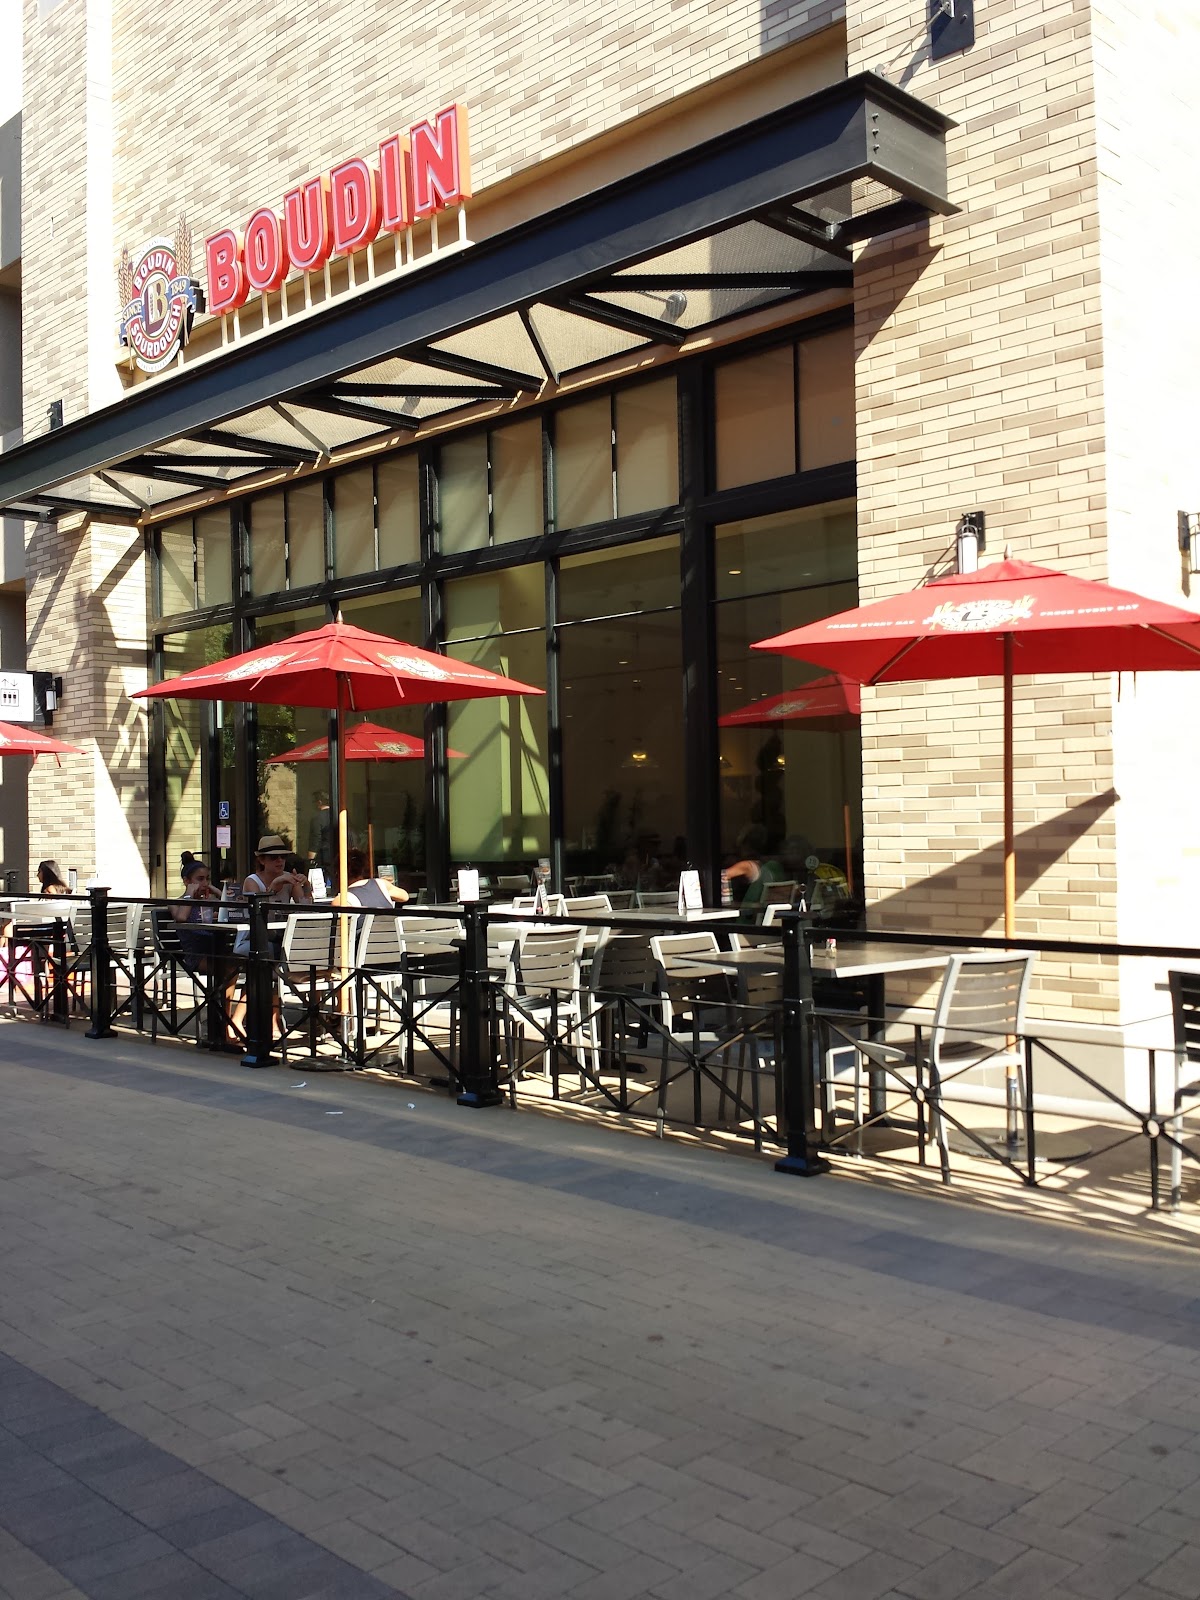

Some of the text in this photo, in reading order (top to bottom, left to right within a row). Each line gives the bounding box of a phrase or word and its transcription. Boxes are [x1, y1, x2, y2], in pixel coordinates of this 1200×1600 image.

[205, 103, 471, 316] BOUDIN
[134, 252, 174, 291] BOUDIN
[123, 301, 142, 320] SINCE
[170, 279, 187, 296] 1849
[131, 304, 181, 357] SOURDOUGH
